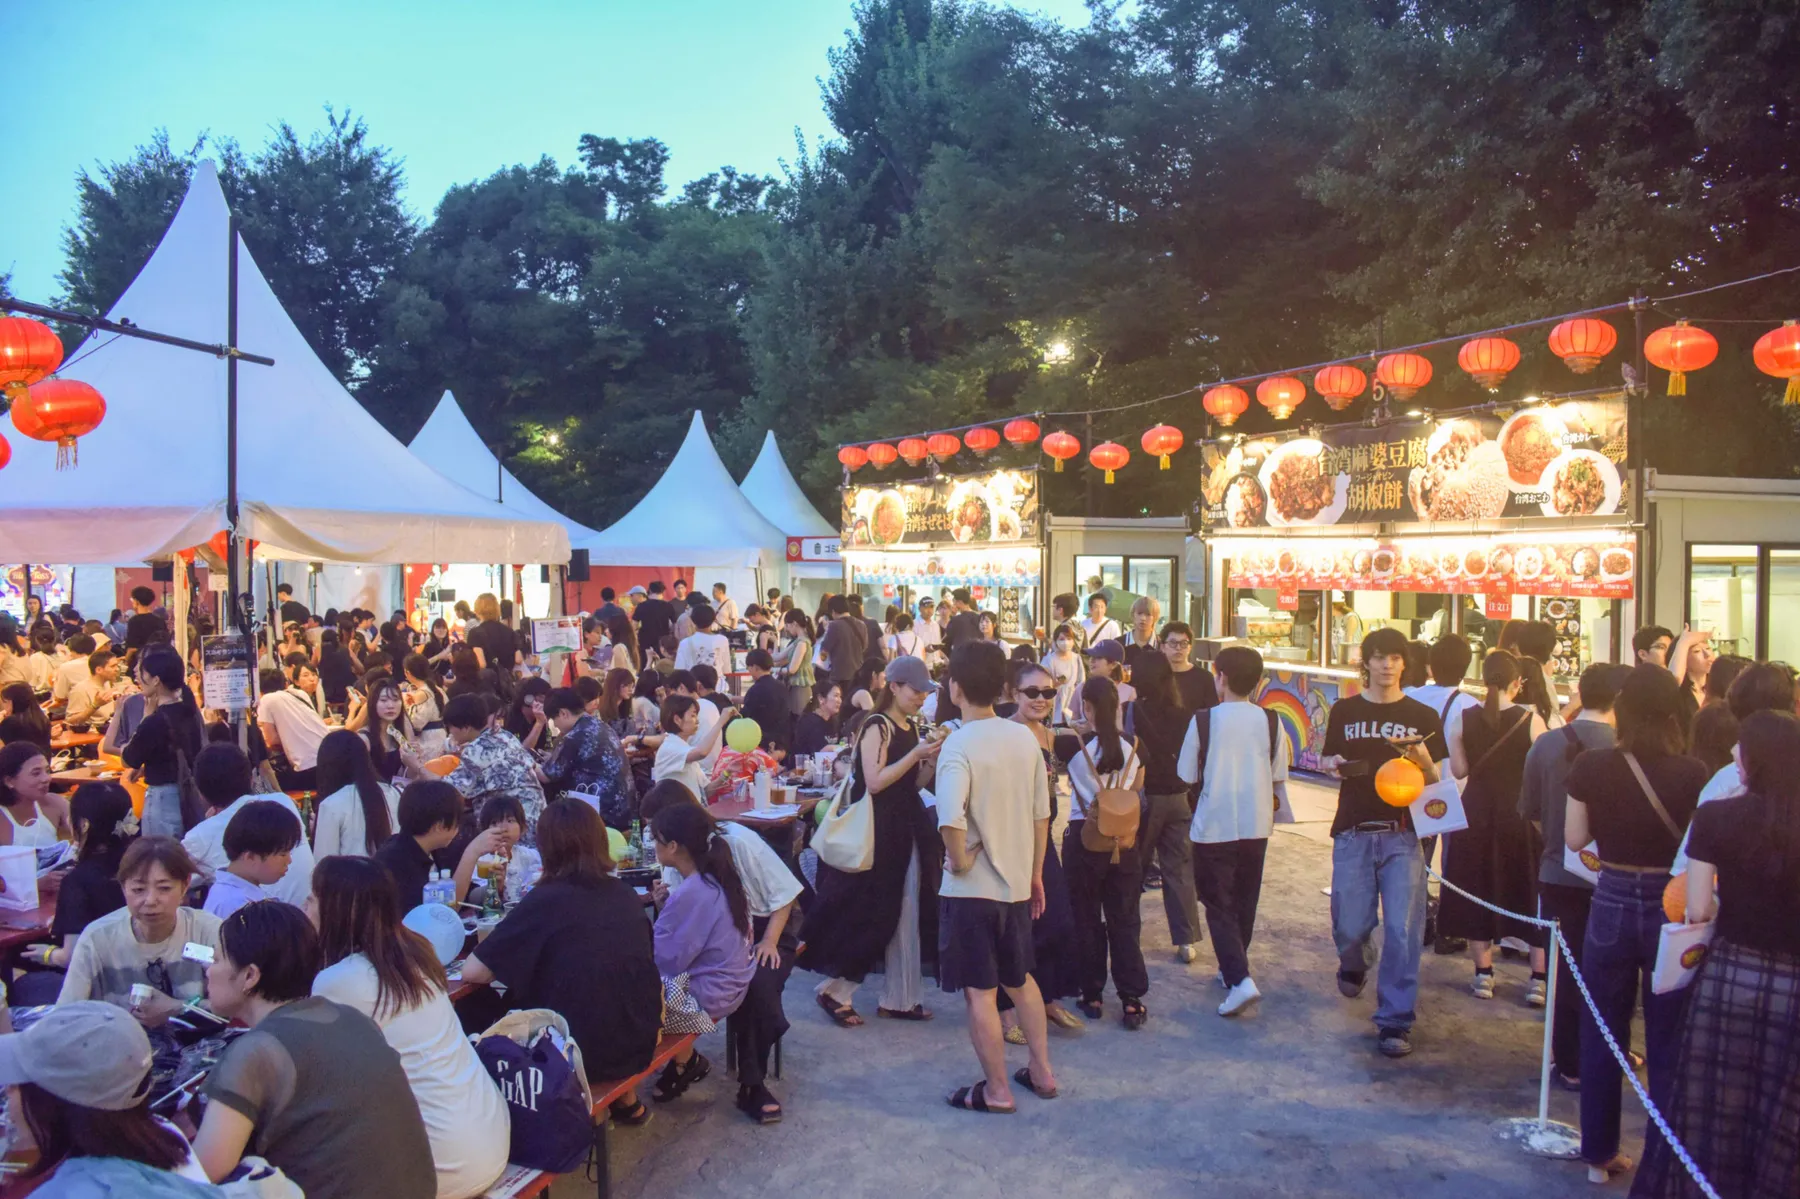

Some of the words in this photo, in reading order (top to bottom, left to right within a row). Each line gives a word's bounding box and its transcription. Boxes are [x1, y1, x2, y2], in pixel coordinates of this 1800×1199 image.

[1373, 378, 1385, 401] 5
[1318, 437, 1428, 476] 台湾麻婆豆腐
[1348, 480, 1403, 512] 胡椒餅
[497, 1059, 543, 1112] GAP
